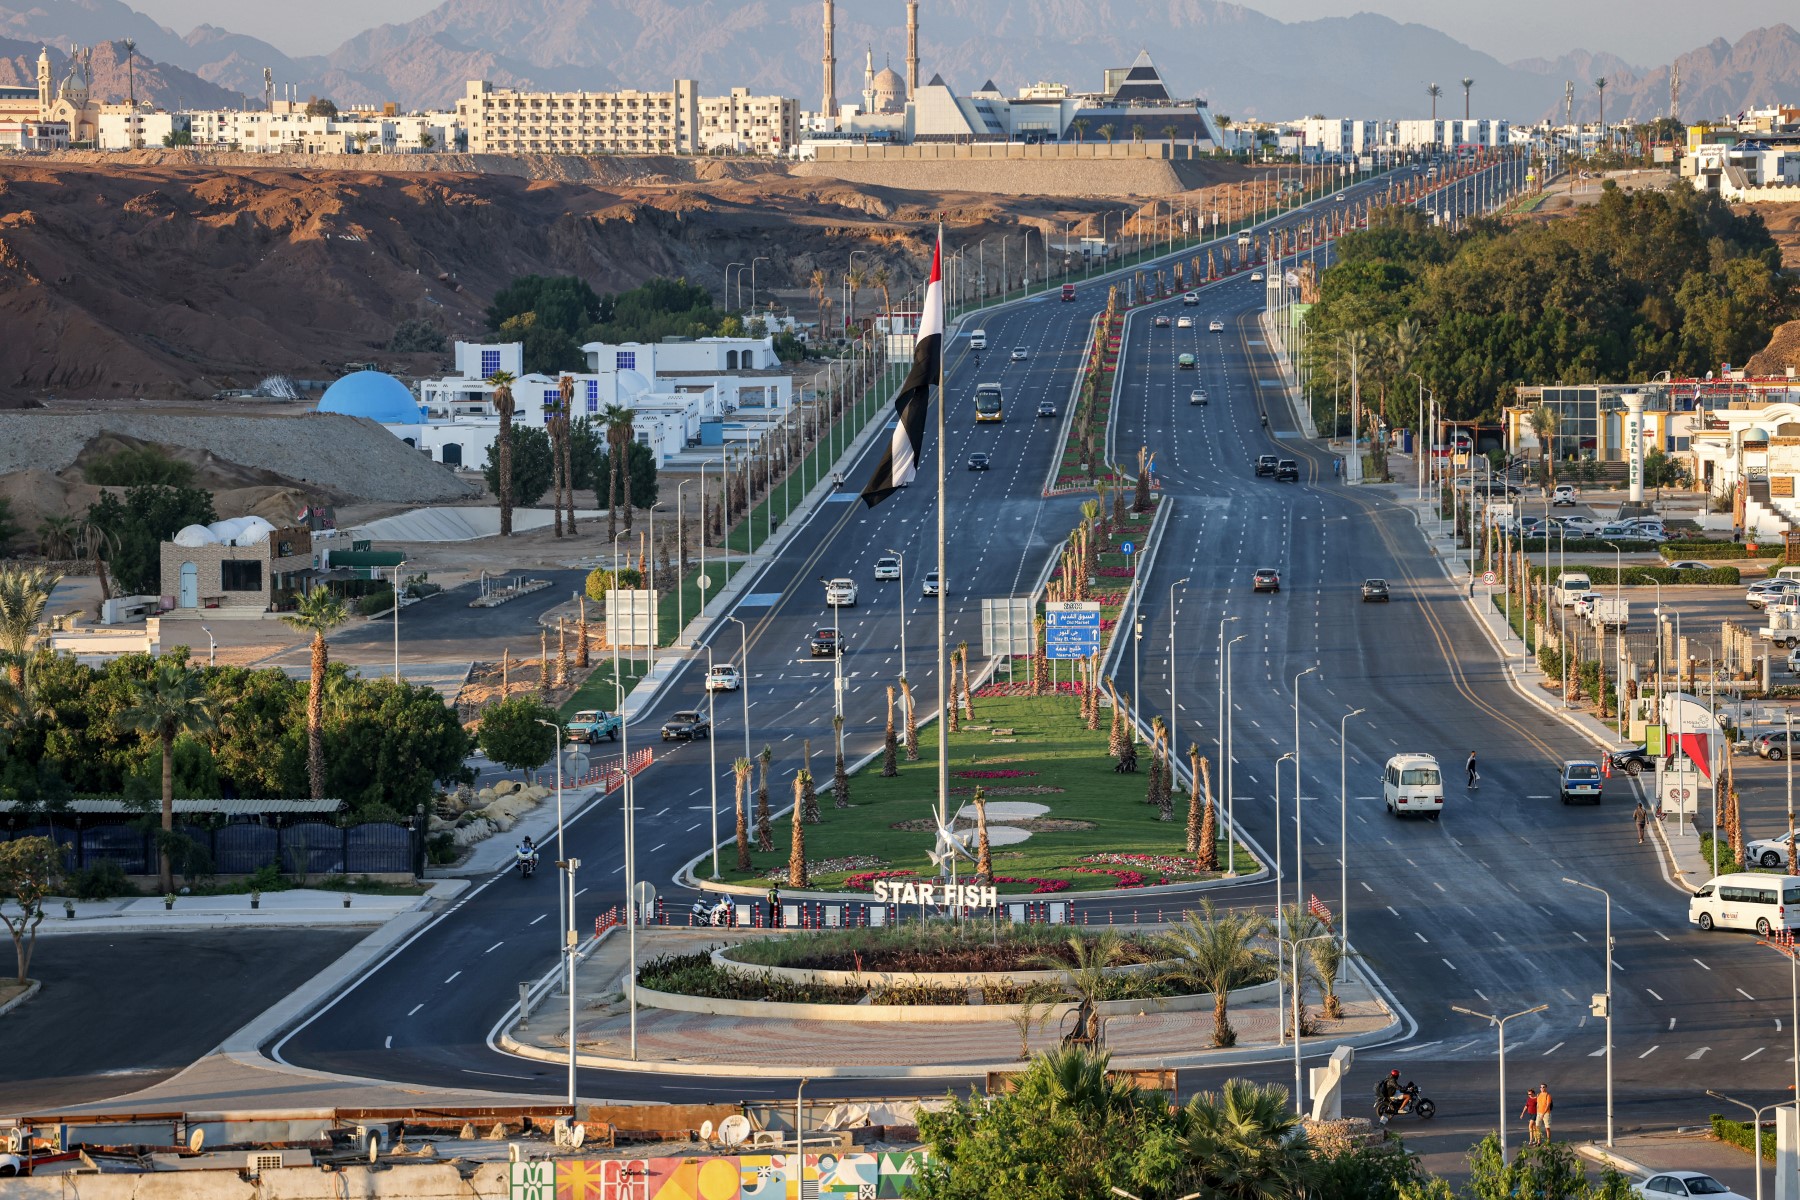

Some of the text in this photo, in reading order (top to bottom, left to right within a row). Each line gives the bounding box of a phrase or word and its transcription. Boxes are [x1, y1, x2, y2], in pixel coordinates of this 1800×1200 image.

[1630, 421, 1639, 484] ROYAL GATE
[1484, 574, 1494, 582] 60
[874, 880, 997, 908] STAR FISH
